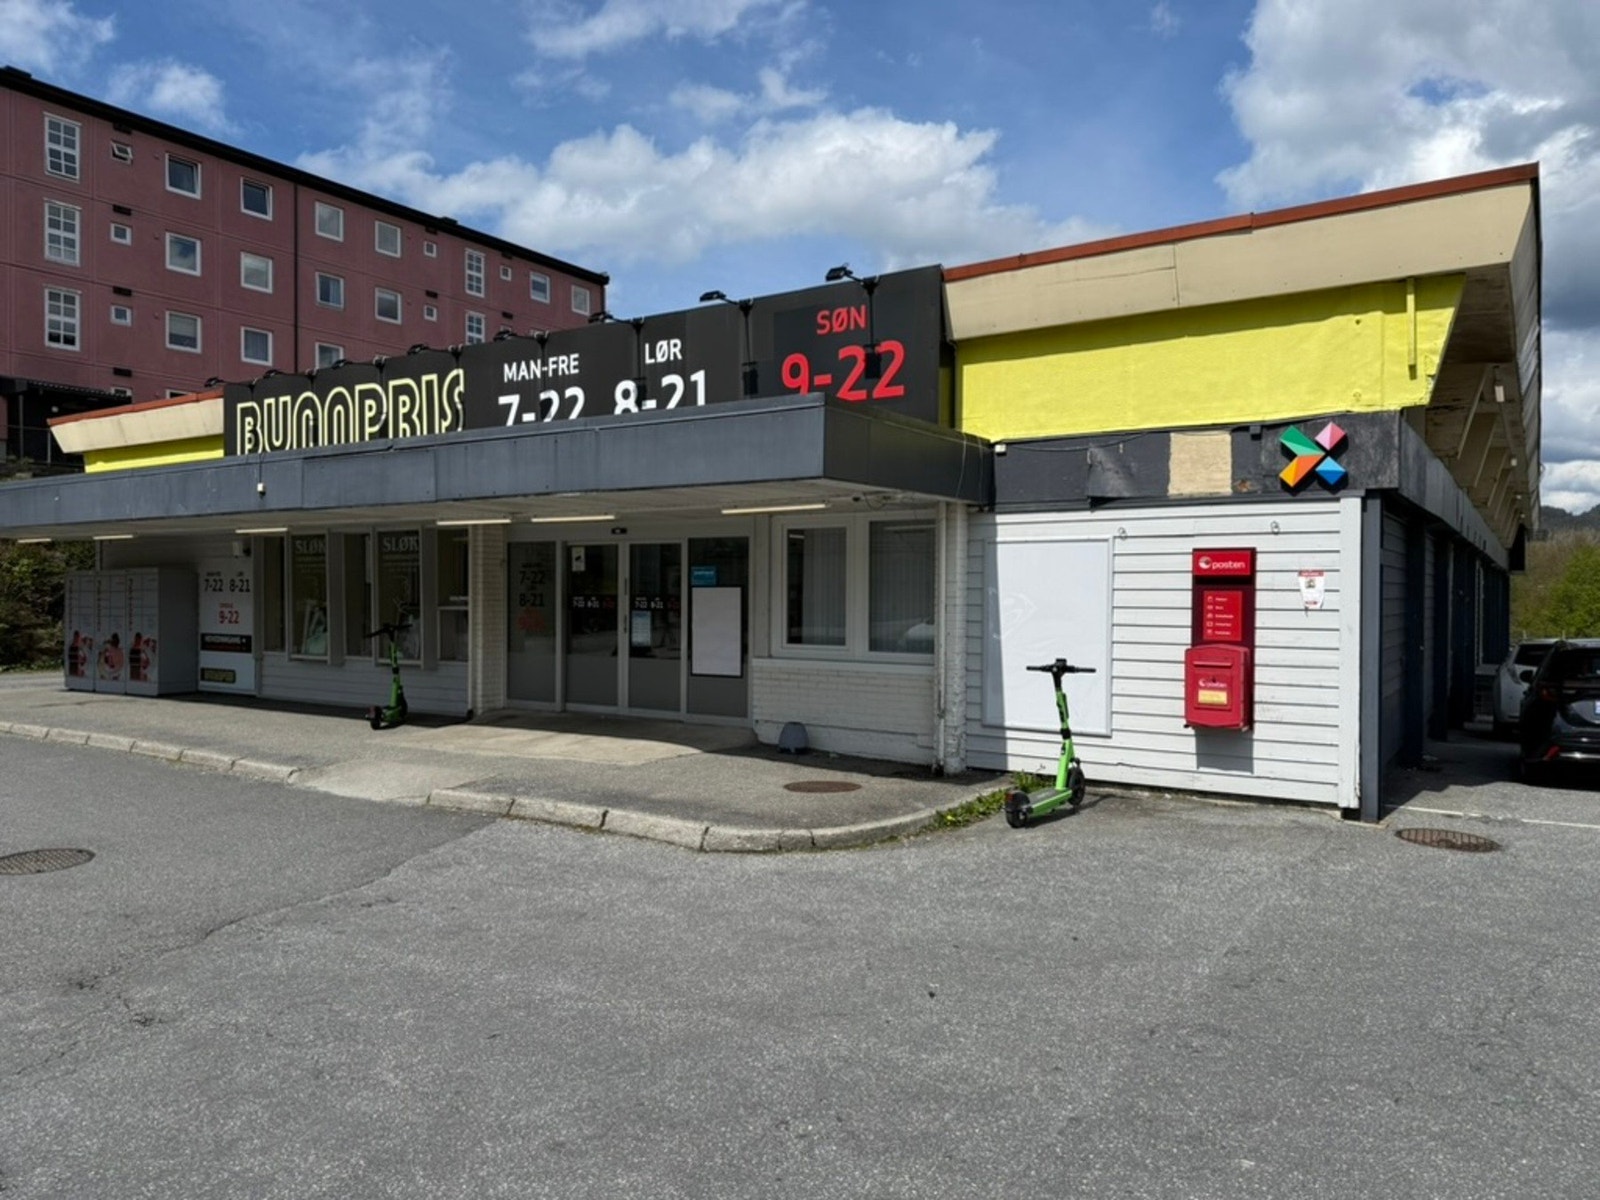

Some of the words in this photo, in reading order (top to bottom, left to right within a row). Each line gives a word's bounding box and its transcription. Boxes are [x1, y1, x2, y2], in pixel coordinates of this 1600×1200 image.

[816, 304, 867, 335] SØN
[644, 338, 682, 364] LØR
[503, 353, 580, 383] MAN-FRE
[781, 340, 905, 401] 9-22
[613, 369, 706, 416] 8-21
[237, 368, 464, 456] BUNNPRIS
[498, 386, 586, 427] 7-22
[519, 570, 546, 585] 7-22
[1212, 560, 1246, 570] posten
[204, 578, 224, 593] 7-22
[229, 578, 251, 593] 8-21
[519, 593, 545, 607] 8-21
[218, 610, 240, 624] 9-22
